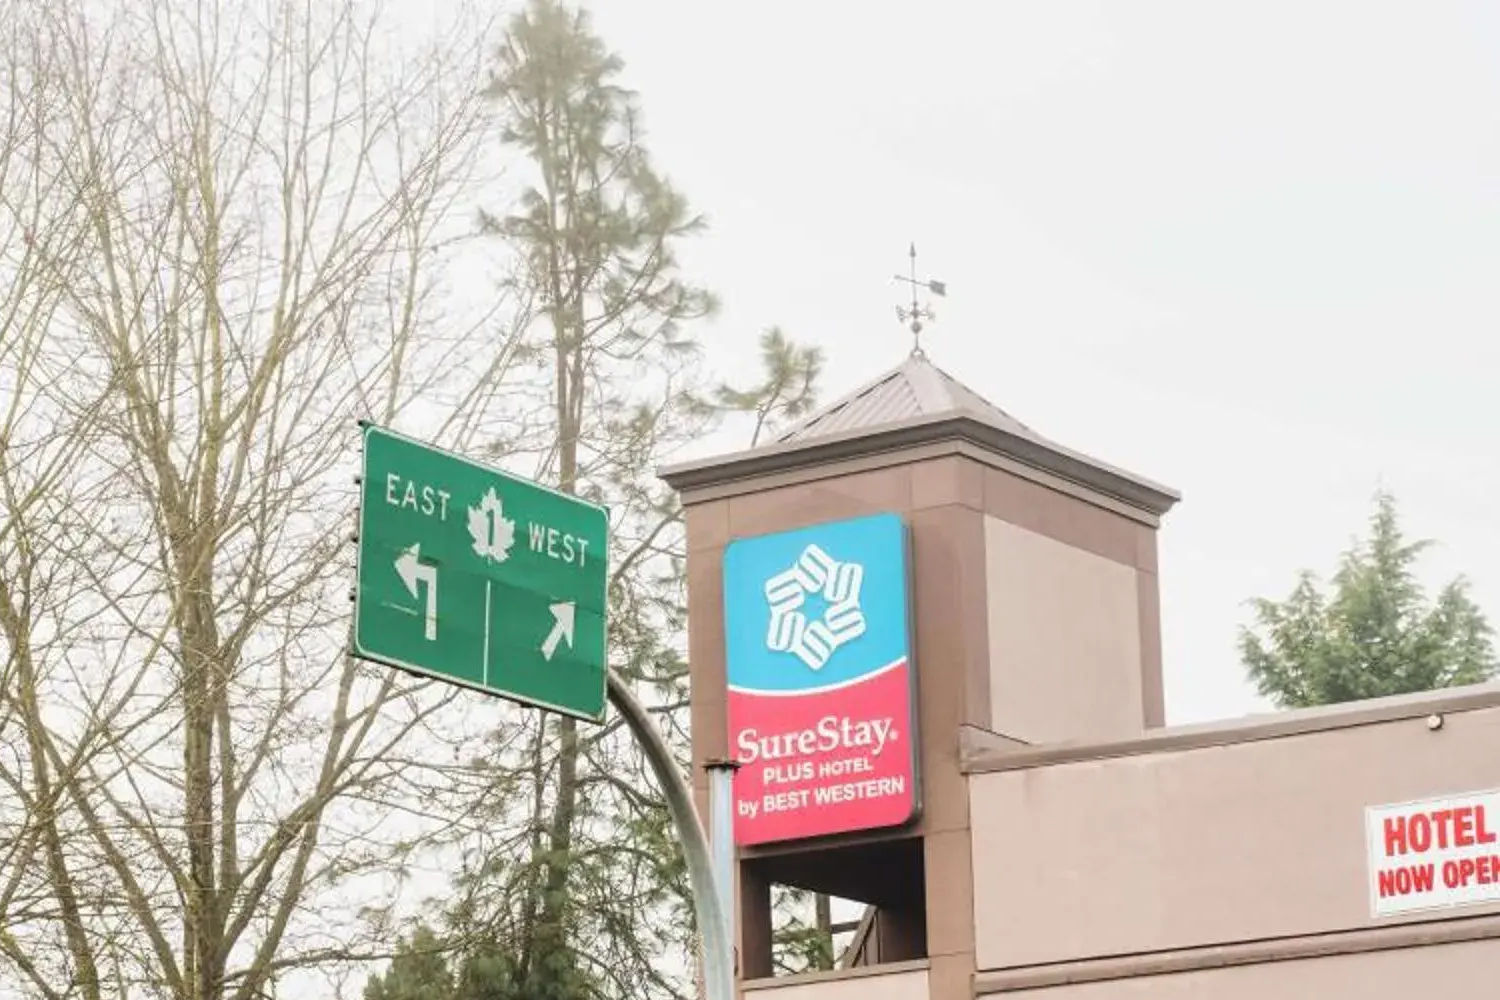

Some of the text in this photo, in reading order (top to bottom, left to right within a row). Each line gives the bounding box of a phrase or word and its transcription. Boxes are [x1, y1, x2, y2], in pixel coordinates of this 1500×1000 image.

[385, 472, 451, 521] EAST
[528, 521, 589, 567] WEST
[763, 757, 874, 785] PLUS HOTEL
[738, 775, 905, 819] by BEST WESTERN
[1384, 805, 1496, 856] HOTEL
[1379, 863, 1435, 898] NOW
